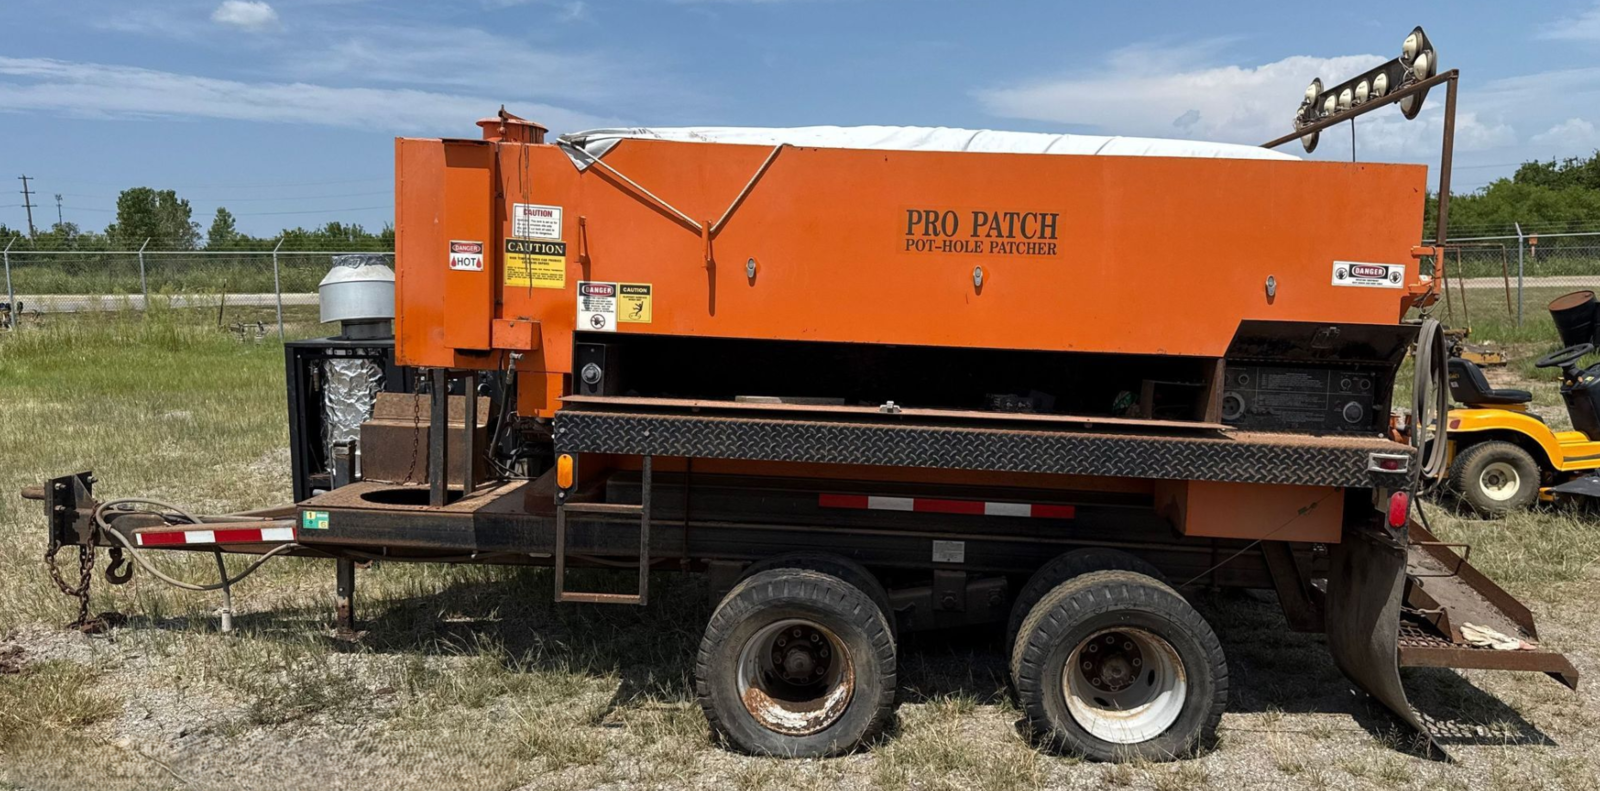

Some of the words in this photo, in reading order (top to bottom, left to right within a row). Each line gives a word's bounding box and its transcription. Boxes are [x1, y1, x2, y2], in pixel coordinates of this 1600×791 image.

[523, 208, 553, 218] CAUTION
[905, 209, 959, 237] PRO
[970, 211, 1060, 240] PATCH
[507, 241, 564, 254] CAUTION
[905, 238, 983, 253] POT-HOLE
[988, 240, 1057, 255] PATCHER
[457, 256, 477, 266] HOT
[1355, 267, 1383, 276] DANGER
[585, 286, 612, 294] DANGER
